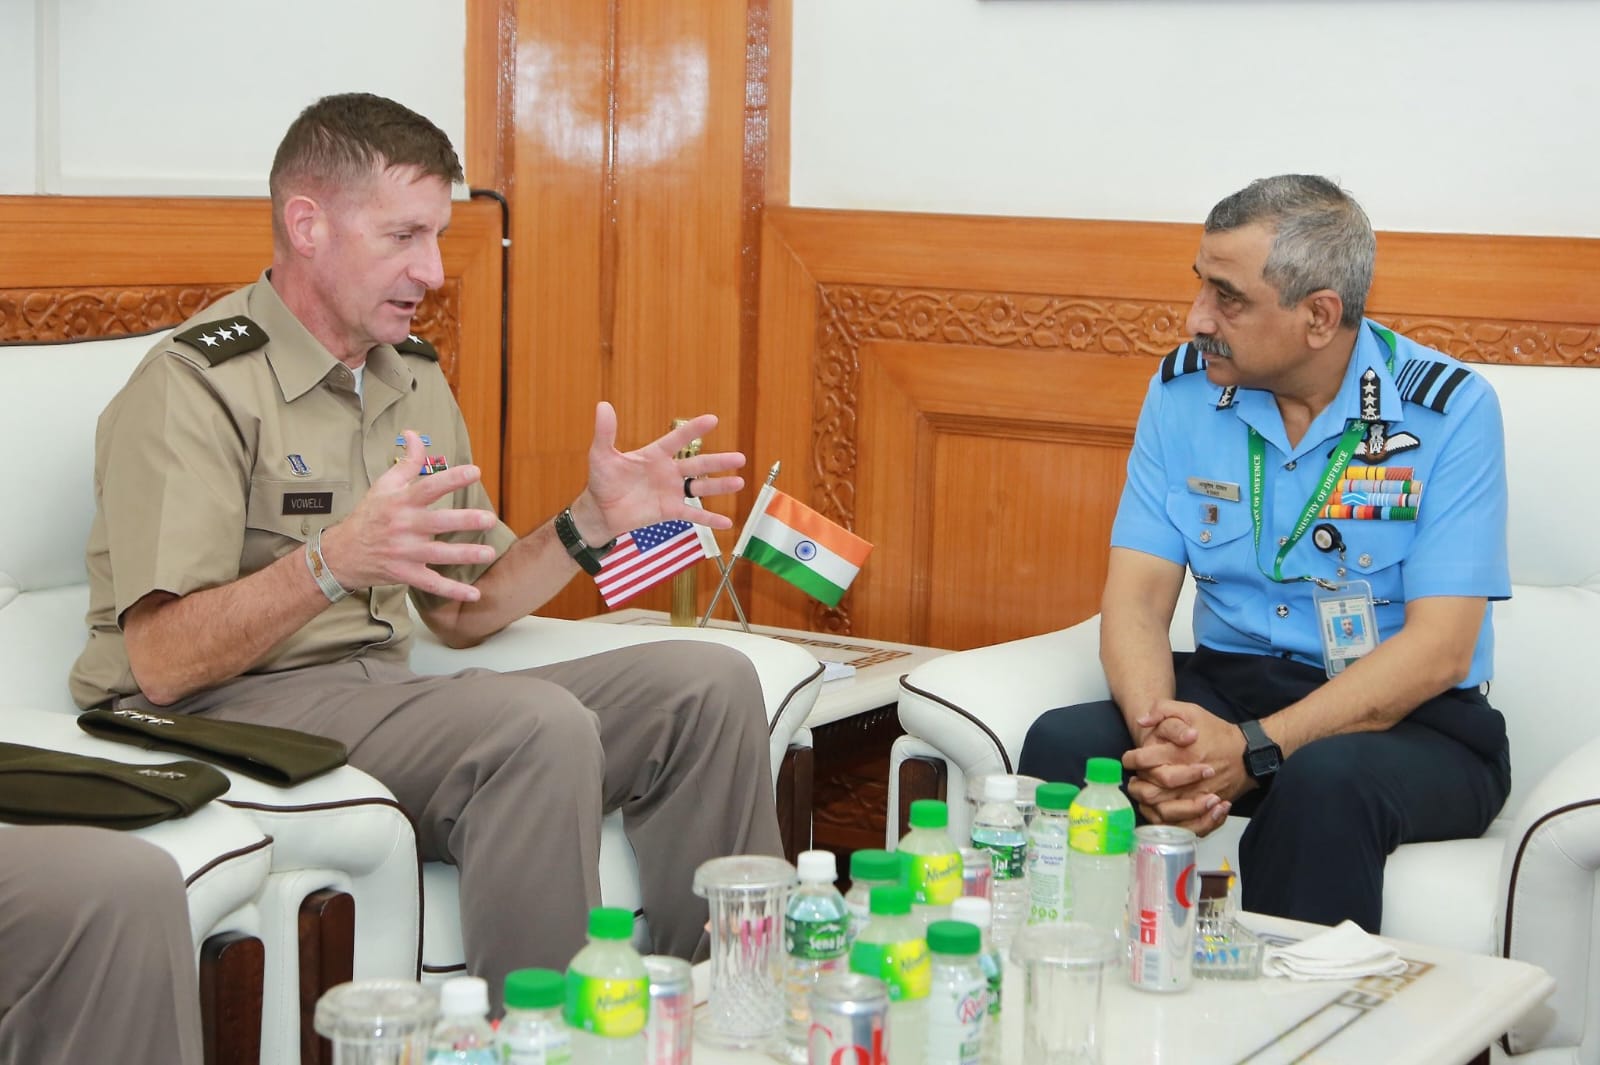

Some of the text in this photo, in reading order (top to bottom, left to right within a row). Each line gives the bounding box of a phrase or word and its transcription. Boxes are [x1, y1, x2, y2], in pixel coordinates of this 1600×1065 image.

[291, 498, 325, 509] VOWELL
[1292, 450, 1349, 541] MINISTRY OF DEFENCE
